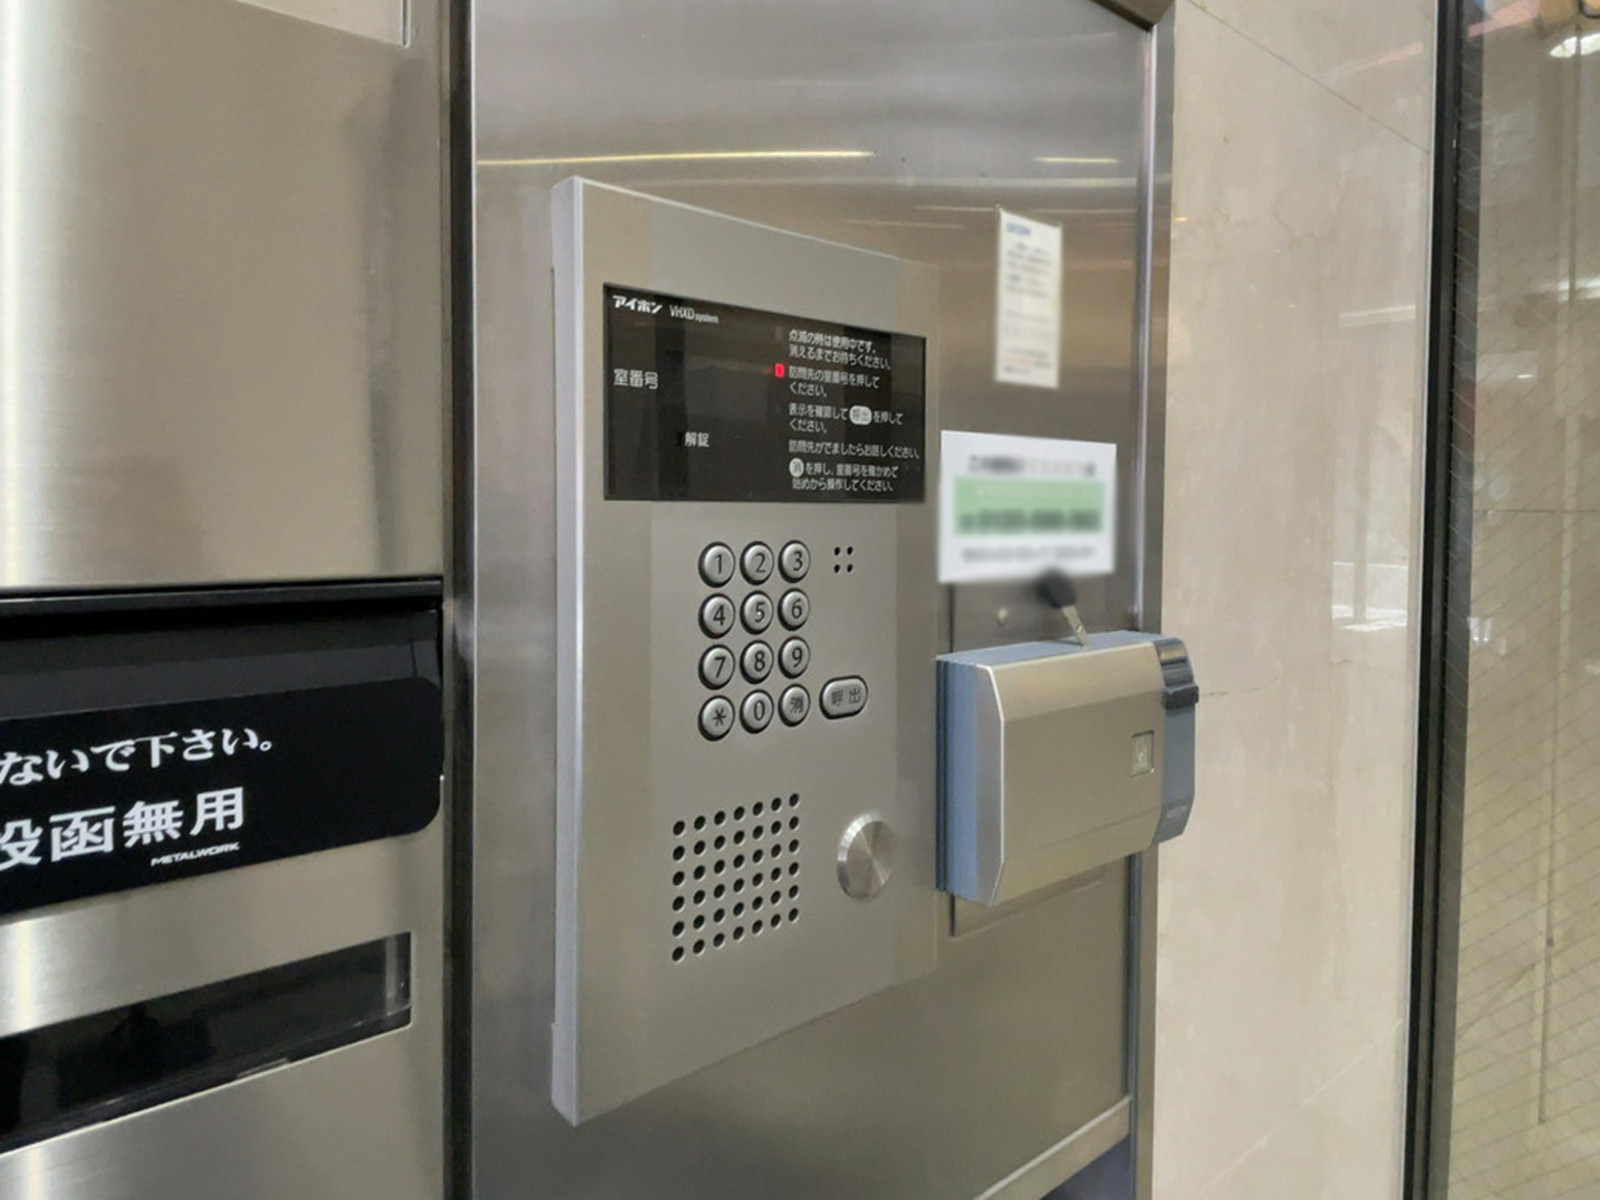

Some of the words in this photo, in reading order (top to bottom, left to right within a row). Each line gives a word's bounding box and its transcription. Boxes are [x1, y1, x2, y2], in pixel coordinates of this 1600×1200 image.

[612, 295, 663, 314] アイホン
[789, 343, 891, 370] 消えるまでお待ちください。
[613, 368, 658, 390] 室番号
[789, 365, 880, 389] 訪問先の室番号を押して
[790, 381, 827, 397] ください。
[790, 418, 827, 434] ください。
[715, 553, 723, 574] 1
[756, 552, 766, 573] 2
[794, 551, 803, 571] 3
[713, 605, 726, 626] 4
[755, 601, 765, 623] 5
[791, 598, 803, 619] 6
[714, 656, 726, 678] 7
[754, 650, 766, 672] 8
[792, 647, 803, 668] 9
[754, 700, 766, 721] 0
[0, 728, 272, 786] ないで下さい。
[150, 842, 241, 867] METALWORK
